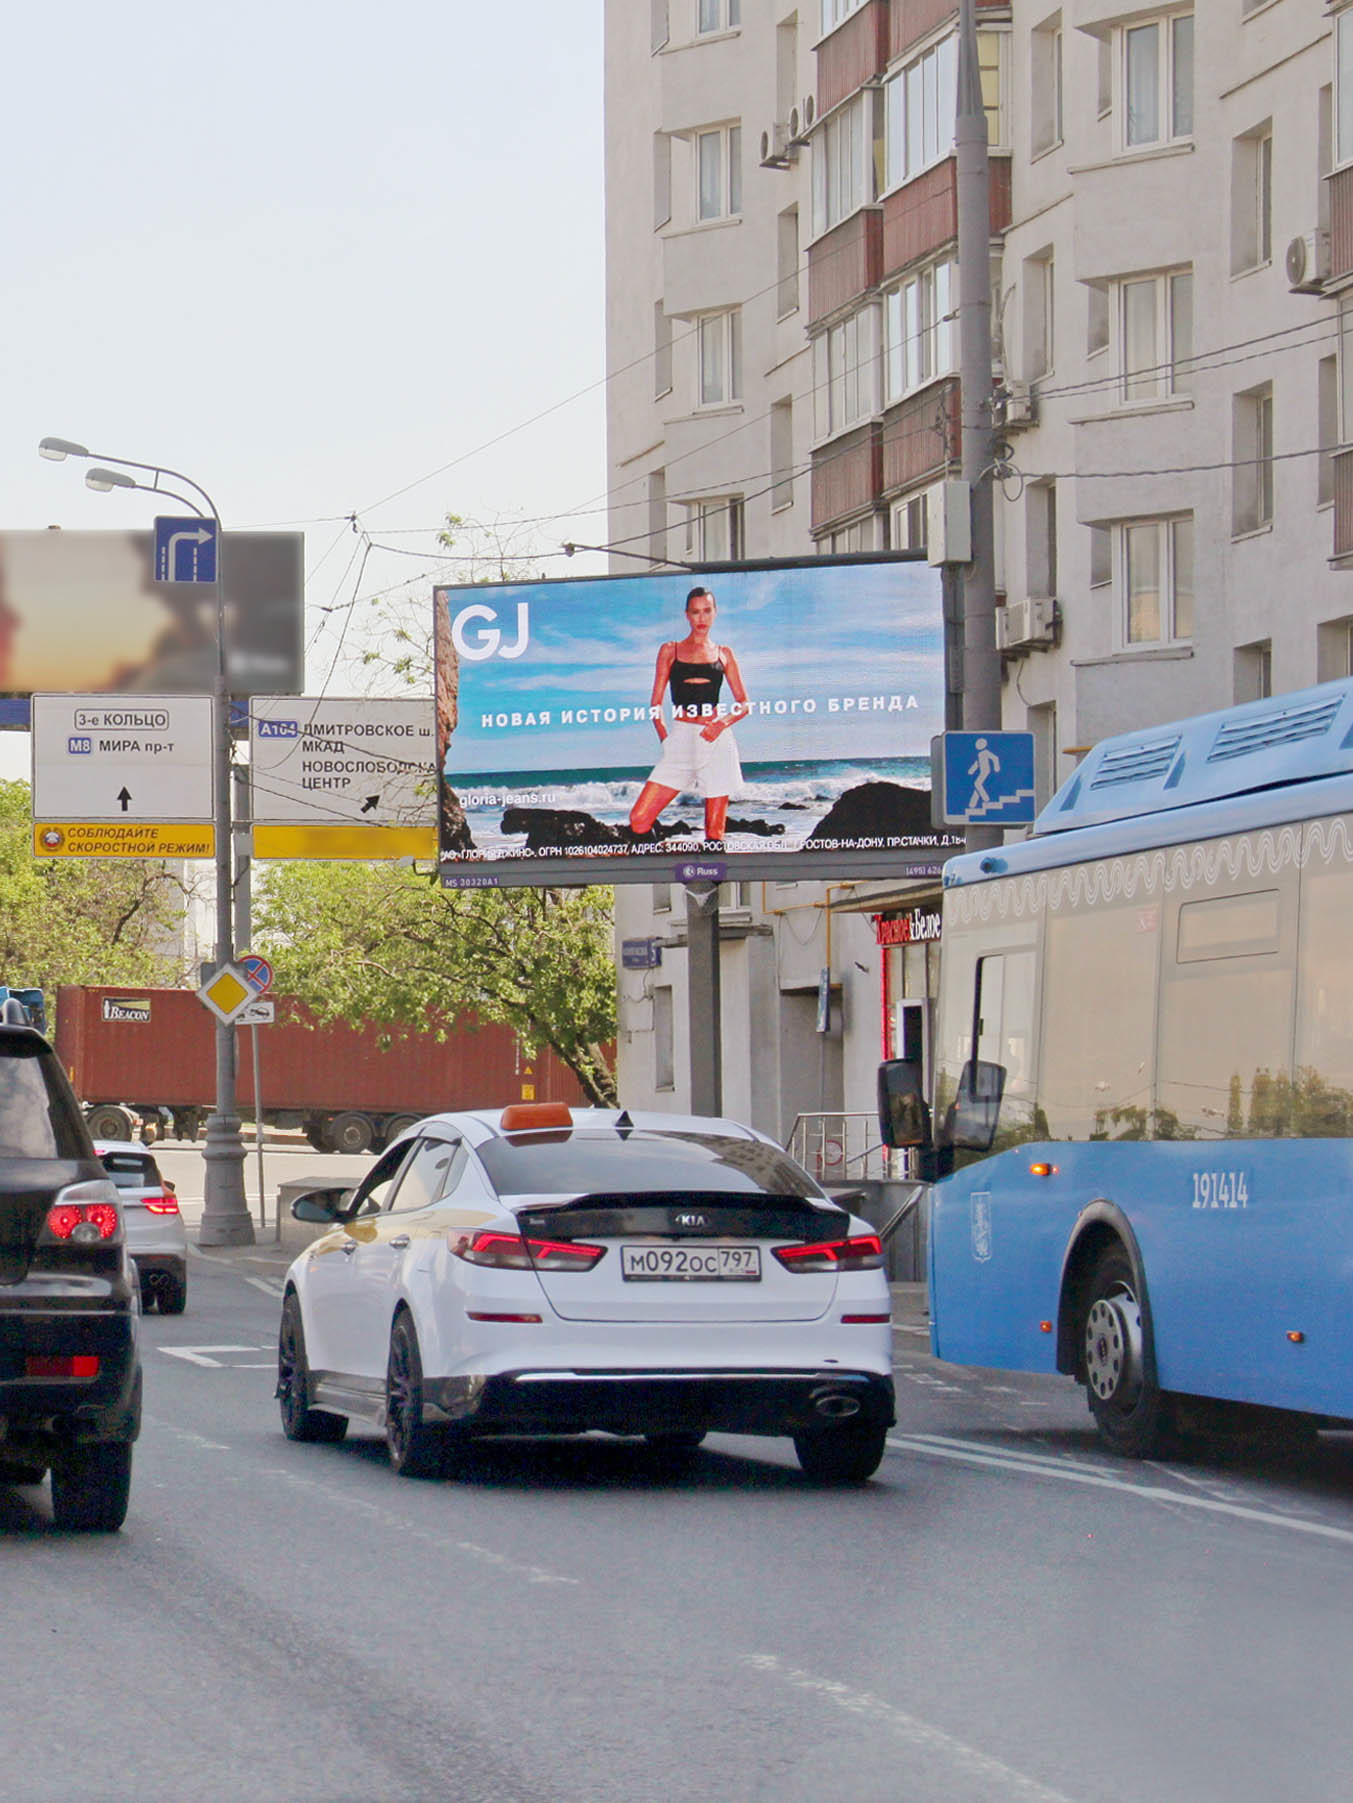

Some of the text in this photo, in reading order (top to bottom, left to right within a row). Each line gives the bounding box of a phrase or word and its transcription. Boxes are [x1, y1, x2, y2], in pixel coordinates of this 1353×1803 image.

[451, 602, 529, 661] GJ
[481, 694, 919, 728] НОВАЯ ИСТОРИЯ ИЗВЕСТНОГО БРЕНДА
[78, 713, 166, 728] 3-е КОЛЬЦО
[304, 723, 415, 738] ДМИТРОВСКОЕ
[418, 729, 435, 737] ш.
[69, 739, 175, 754] М8 МИРА пр-т
[302, 741, 345, 754] МКАД
[302, 777, 352, 791] ЦЕНТР
[458, 792, 556, 808] gloria-jeans.ru
[67, 827, 159, 840] СОБЛЮДАЙТЕ
[67, 841, 210, 854] СКОРОСТНОЙ РЕЖИМ!
[538, 846, 563, 857] ОГРН
[696, 866, 719, 876] Russ
[111, 1005, 150, 1022] BEACON
[1191, 1171, 1249, 1209] 191414
[681, 1215, 705, 1226] KIA
[630, 1250, 752, 1273] М092ОС 797
